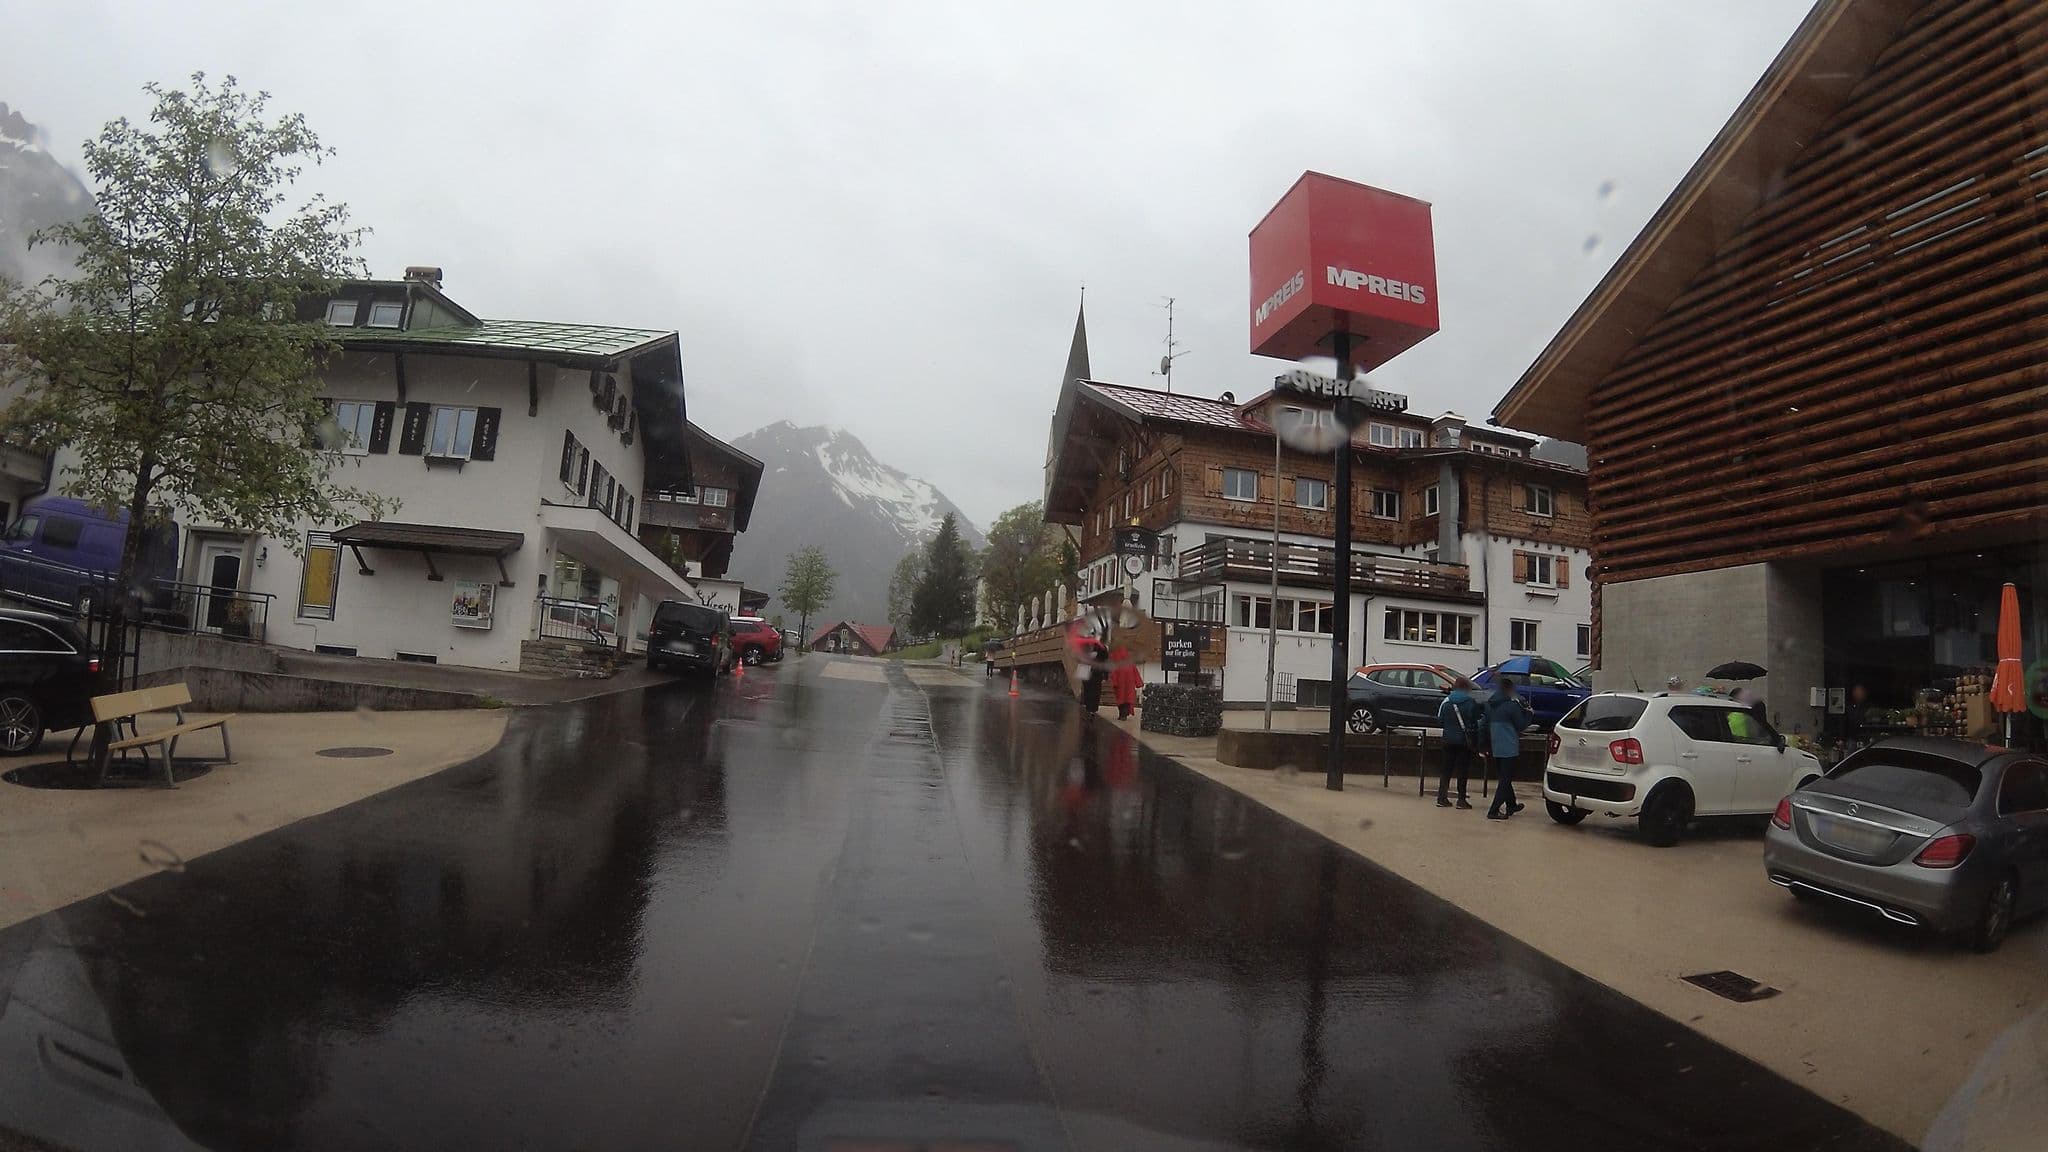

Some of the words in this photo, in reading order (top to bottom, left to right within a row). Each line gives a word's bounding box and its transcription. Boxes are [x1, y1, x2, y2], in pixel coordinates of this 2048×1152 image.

[1255, 269, 1304, 326] MPREIS
[1326, 265, 1426, 304] MPREIS
[1168, 639, 1192, 650] parken
